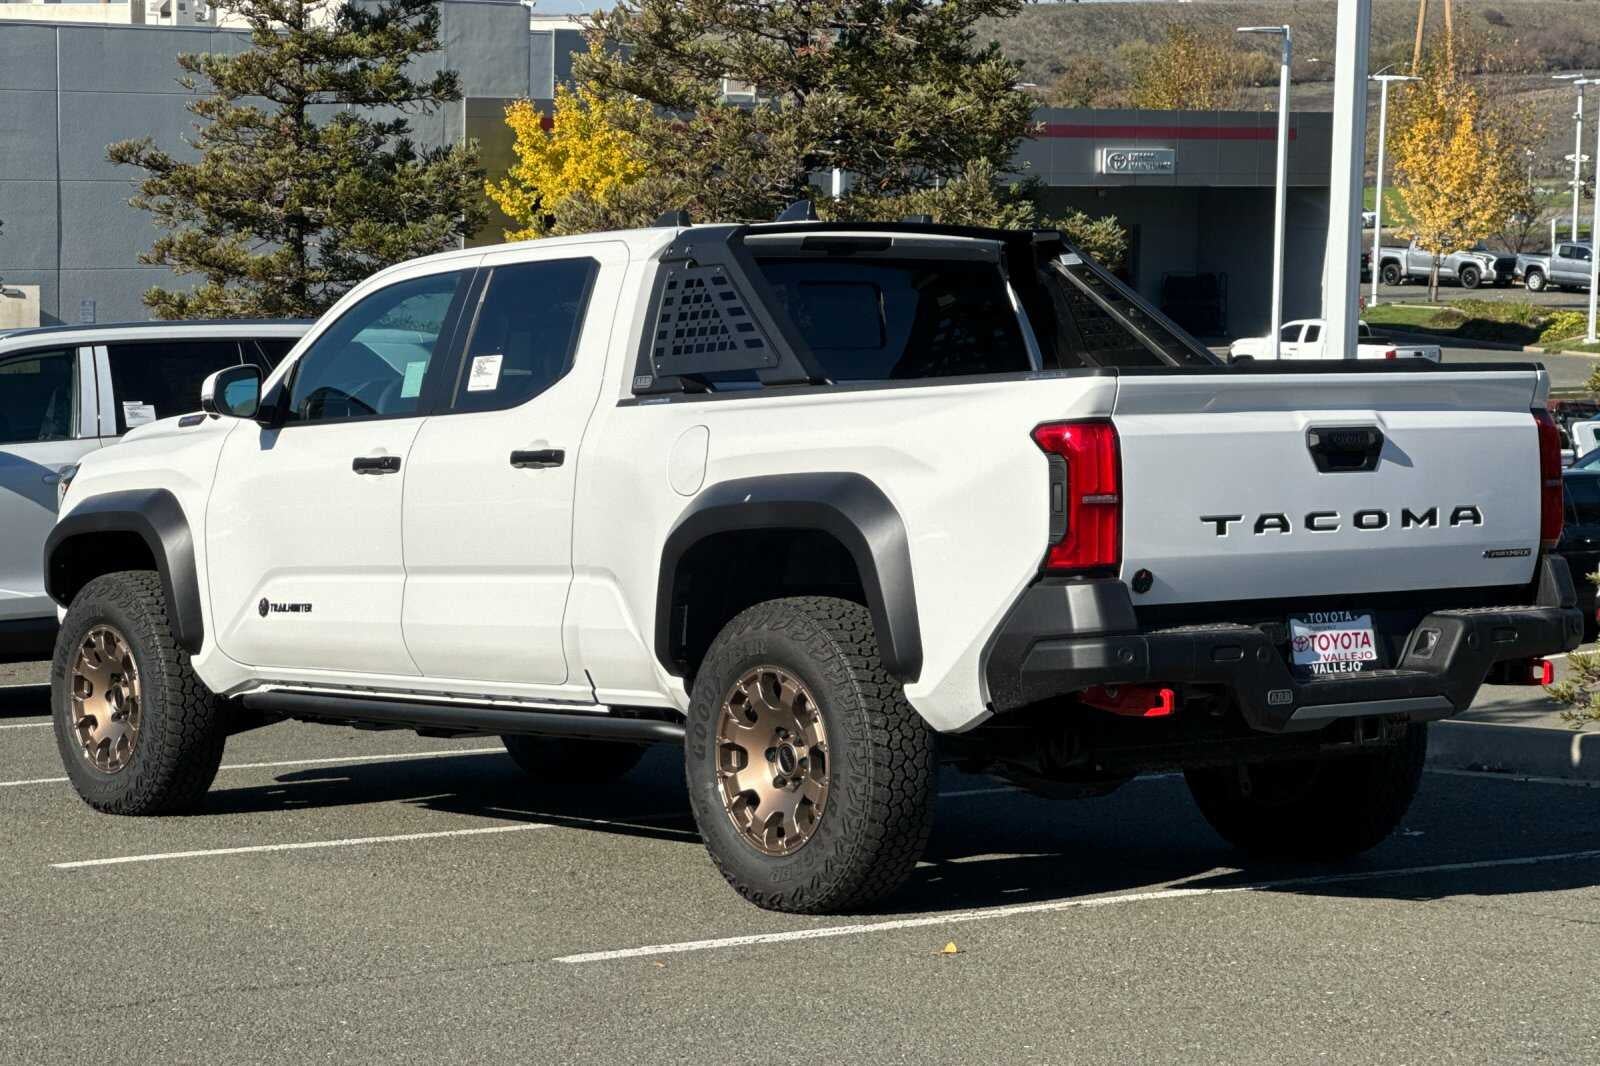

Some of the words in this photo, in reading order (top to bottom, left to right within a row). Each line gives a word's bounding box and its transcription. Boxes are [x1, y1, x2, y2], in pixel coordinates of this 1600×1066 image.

[1200, 504, 1484, 537] TACOMA
[1309, 610, 1353, 623] TOYOTA
[1308, 631, 1372, 652] TOYOTA
[1323, 650, 1373, 662] VALLEJO
[1311, 661, 1361, 674] VALLEJO
